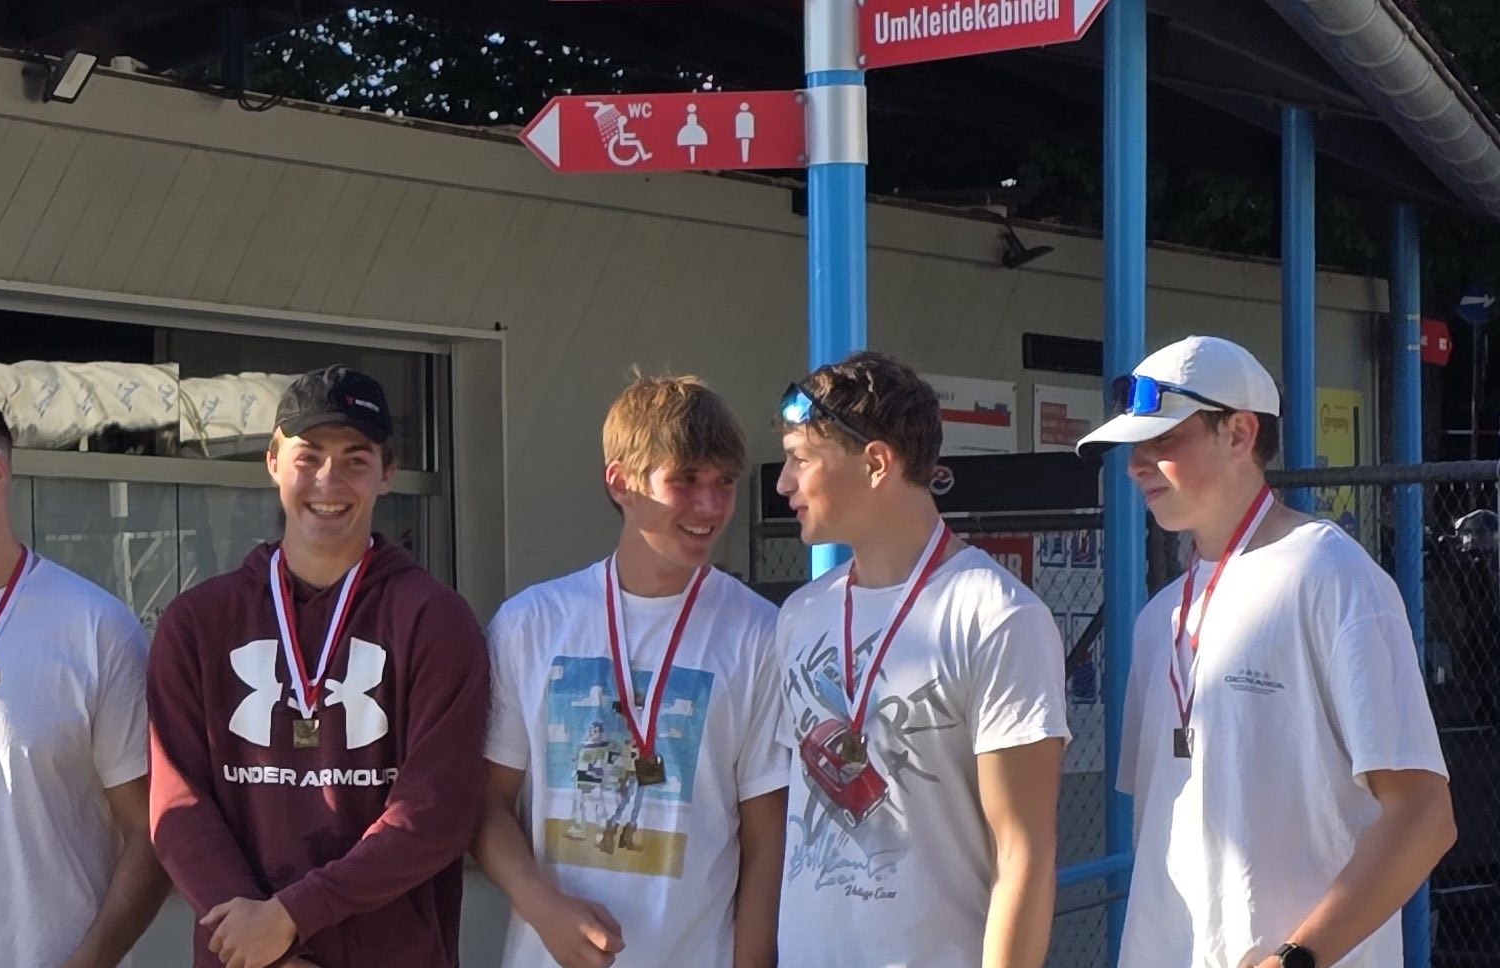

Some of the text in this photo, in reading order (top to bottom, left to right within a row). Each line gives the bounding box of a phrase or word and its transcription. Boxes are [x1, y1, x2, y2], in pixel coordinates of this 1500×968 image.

[875, 0, 1060, 44] Umkleidekabinen
[628, 102, 652, 118] WC
[223, 765, 400, 788] UNDER ARMOUR
